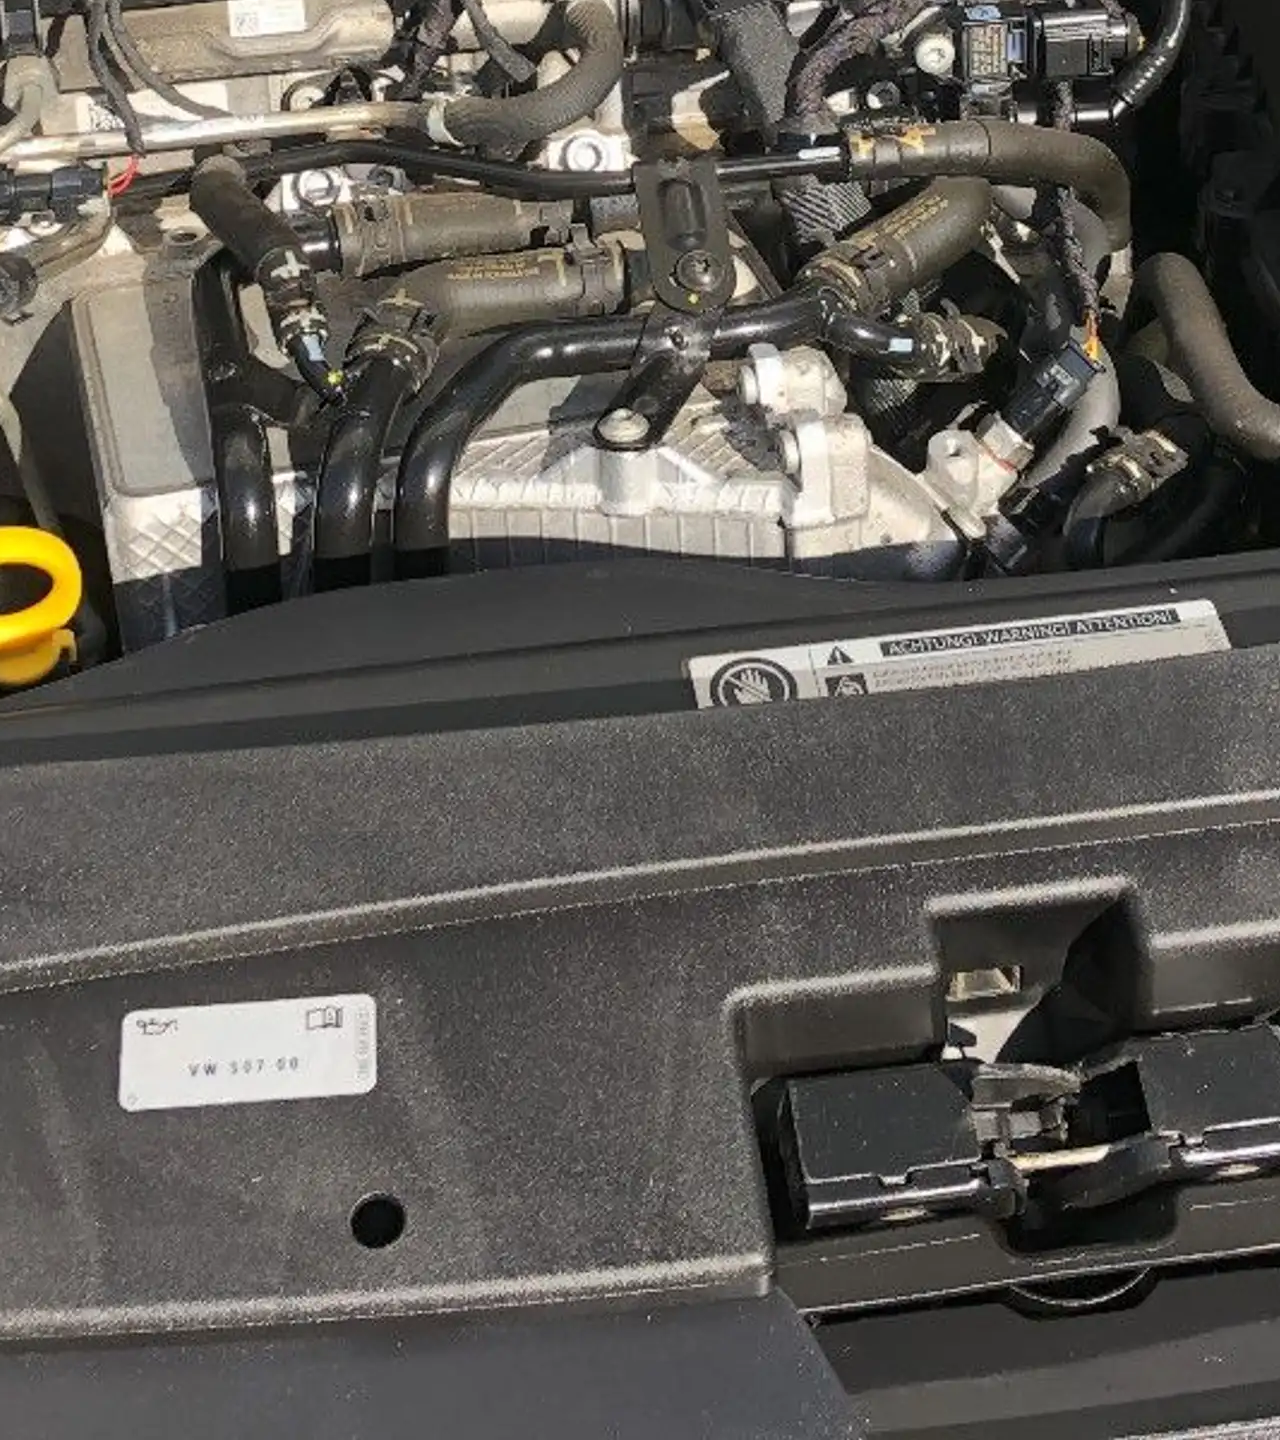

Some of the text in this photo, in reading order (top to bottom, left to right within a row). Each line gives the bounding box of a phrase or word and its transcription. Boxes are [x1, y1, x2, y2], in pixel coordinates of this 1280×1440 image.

[889, 609, 1172, 655] ACHTUNG! WARNING! ATTENTION!
[188, 1062, 217, 1077] VW
